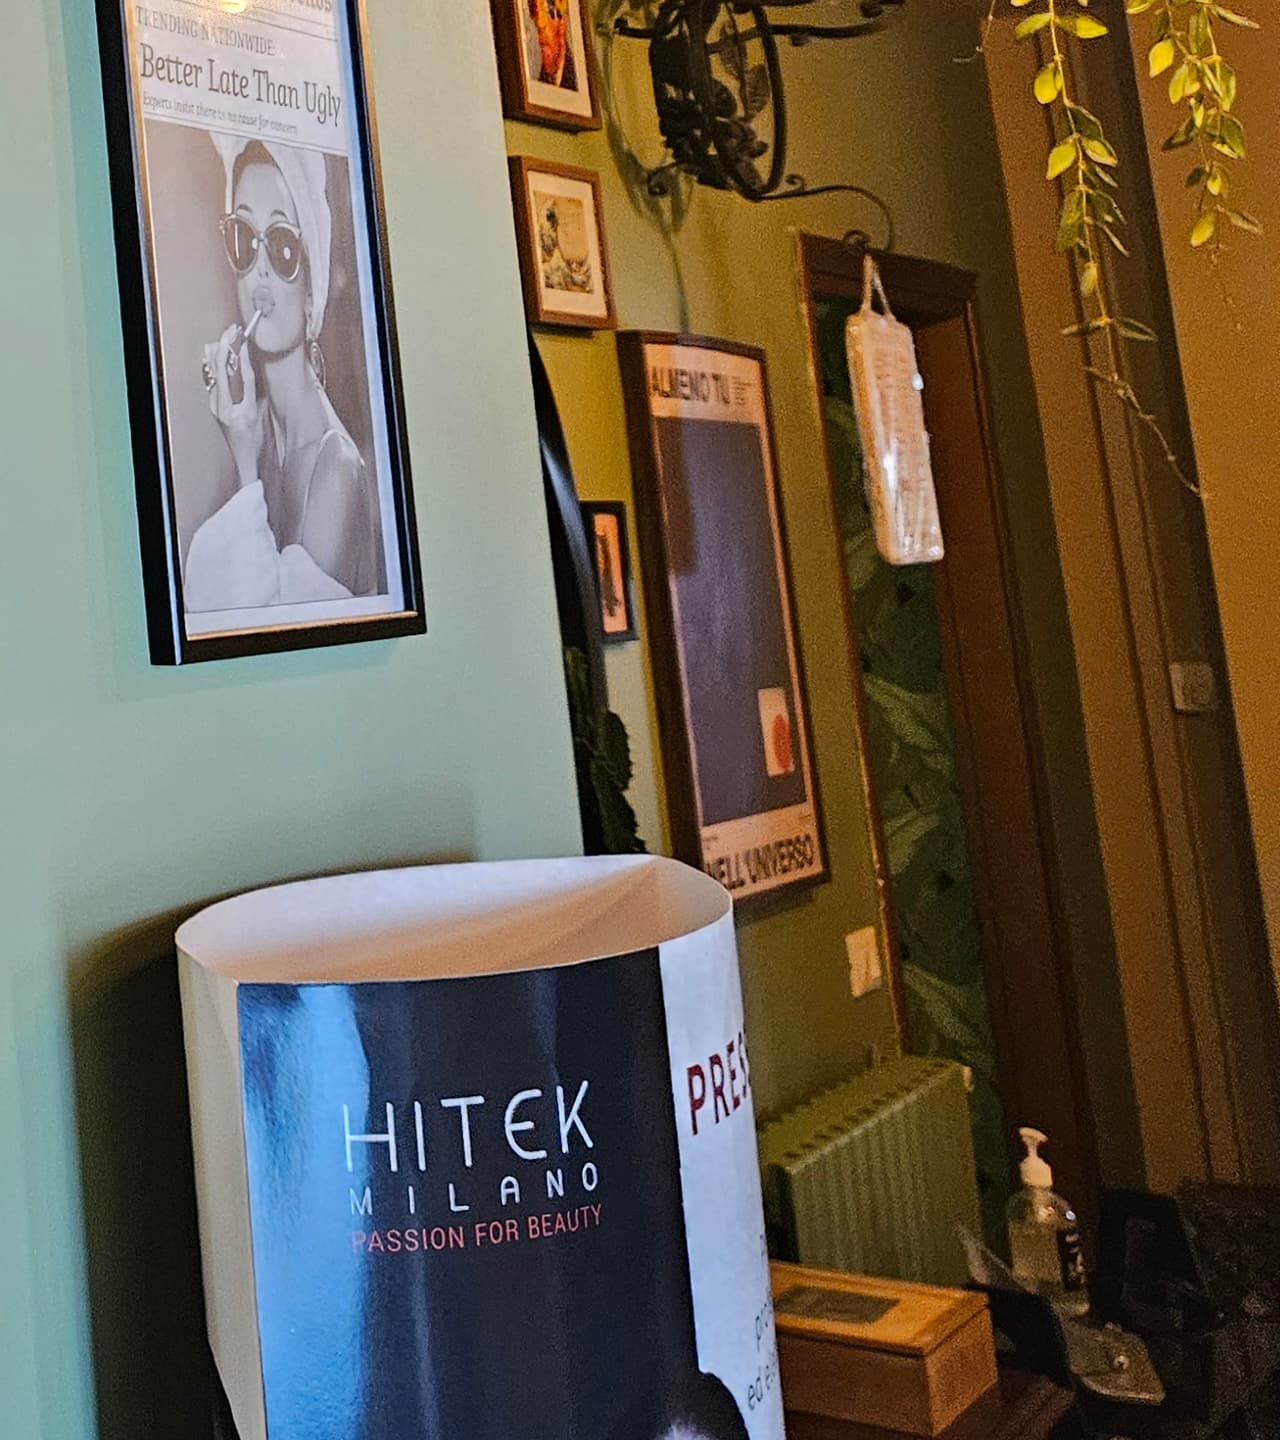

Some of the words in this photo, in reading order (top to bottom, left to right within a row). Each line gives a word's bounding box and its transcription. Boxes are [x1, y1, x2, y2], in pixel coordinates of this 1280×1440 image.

[135, 5, 198, 39] TRENDING
[139, 42, 203, 89] Better
[207, 57, 249, 99] Late
[252, 68, 300, 110] Than
[303, 80, 341, 128] Ugly
[686, 1029, 749, 1136] PRES
[342, 1079, 595, 1173] HITEK
[348, 1161, 600, 1216] MILANO
[351, 1225, 465, 1253] PASSION
[474, 1218, 520, 1248] FOR
[527, 1202, 603, 1240] BEAUTY
